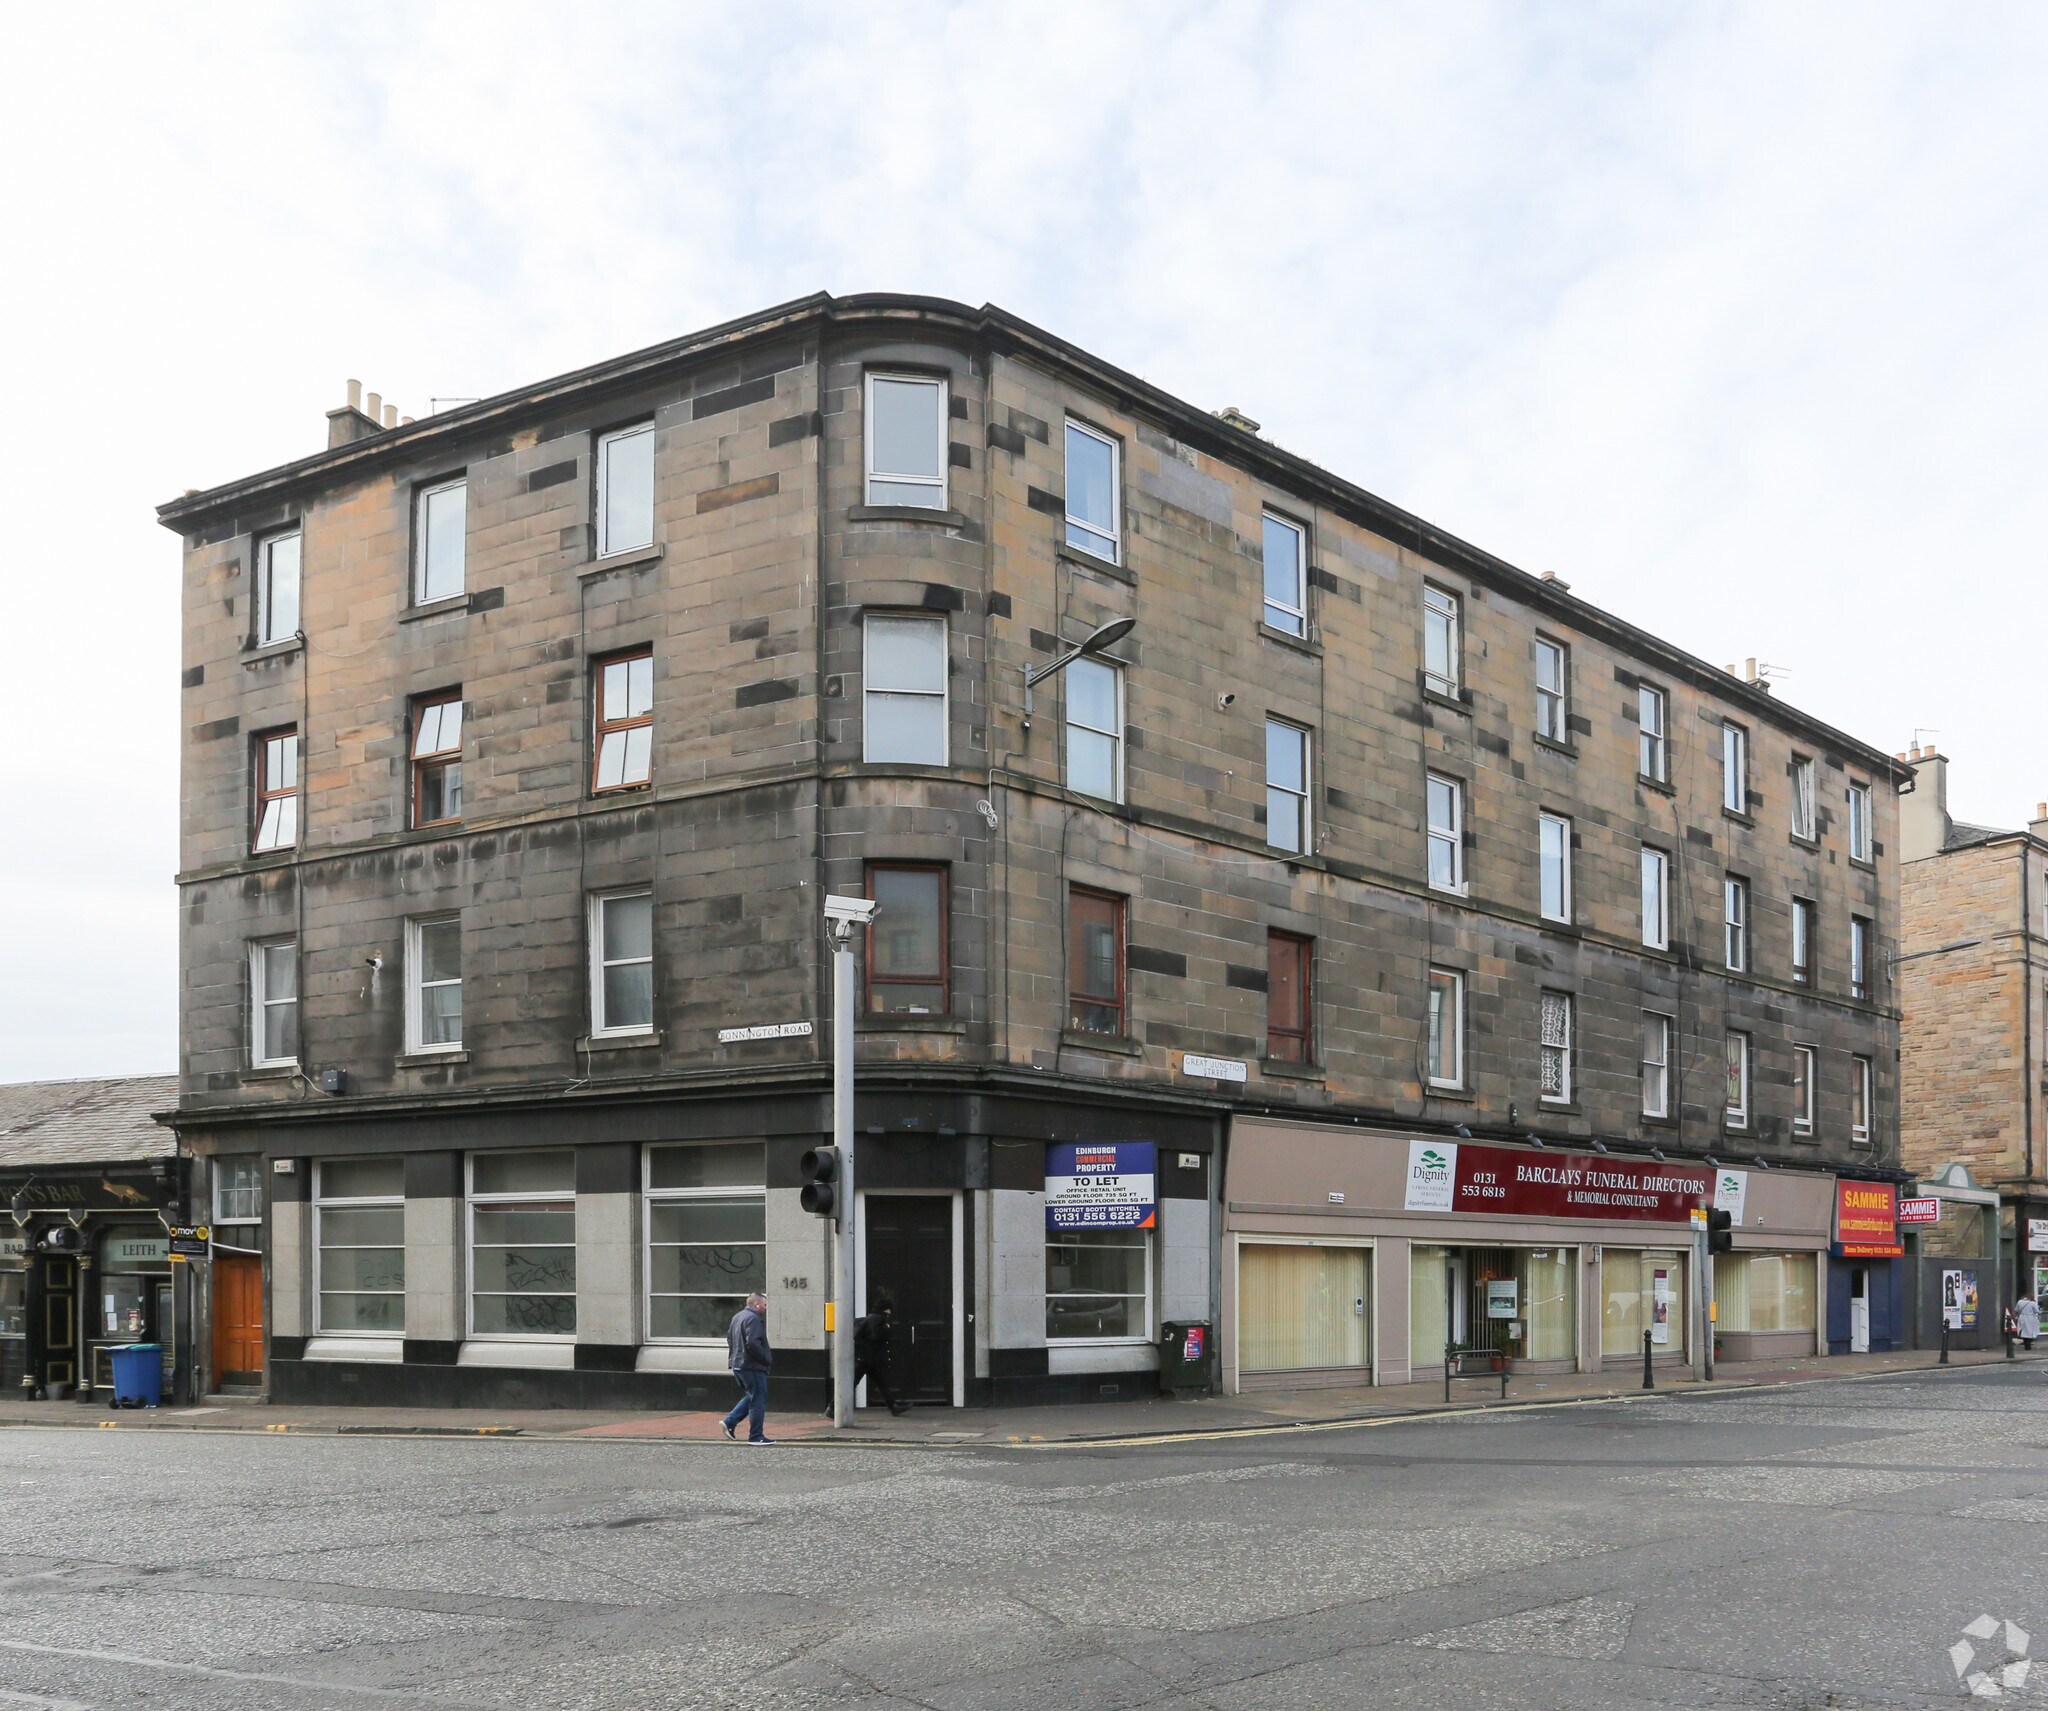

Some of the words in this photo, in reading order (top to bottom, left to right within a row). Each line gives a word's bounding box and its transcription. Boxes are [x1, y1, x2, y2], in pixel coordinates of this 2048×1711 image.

[720, 1027, 781, 1040] BONNINGTON
[784, 1024, 810, 1035] ROAD
[1185, 1058, 1207, 1068] GREAT
[1210, 1061, 1245, 1072] JUNCTION
[1203, 1068, 1227, 1077] STREET
[1076, 1147, 1116, 1155] EDINBURGH
[1076, 1155, 1115, 1163] COMMERCIAL
[1076, 1163, 1116, 1172] PROPERTY
[1413, 1166, 1450, 1184] Dignity
[1473, 1172, 1496, 1184] 0131
[1516, 1165, 1581, 1186] BARCLAYS
[1585, 1171, 1639, 1190] FUNERAL
[1642, 1176, 1705, 1195] DIRECTORS
[1073, 1178, 1090, 1186] TO
[1096, 1177, 1119, 1185] LET
[46, 1185, 86, 1202] BAR
[1461, 1185, 1480, 1196] 553
[1482, 1186, 1505, 1198] 6818
[1567, 1190, 1573, 1203] &
[1574, 1191, 1610, 1205] MEMORIAL
[1611, 1193, 1658, 1208] CONSULTANTS
[1844, 1190, 1889, 1210] SAMMIE
[1900, 1201, 1935, 1215] SAMMIE
[1054, 1213, 1079, 1221] 0131
[1083, 1212, 1106, 1220] 556
[1110, 1211, 1140, 1220] 6222
[122, 1244, 156, 1256] LEITH
[1857, 1246, 1873, 1254] Delivery
[782, 1277, 807, 1289] 145
